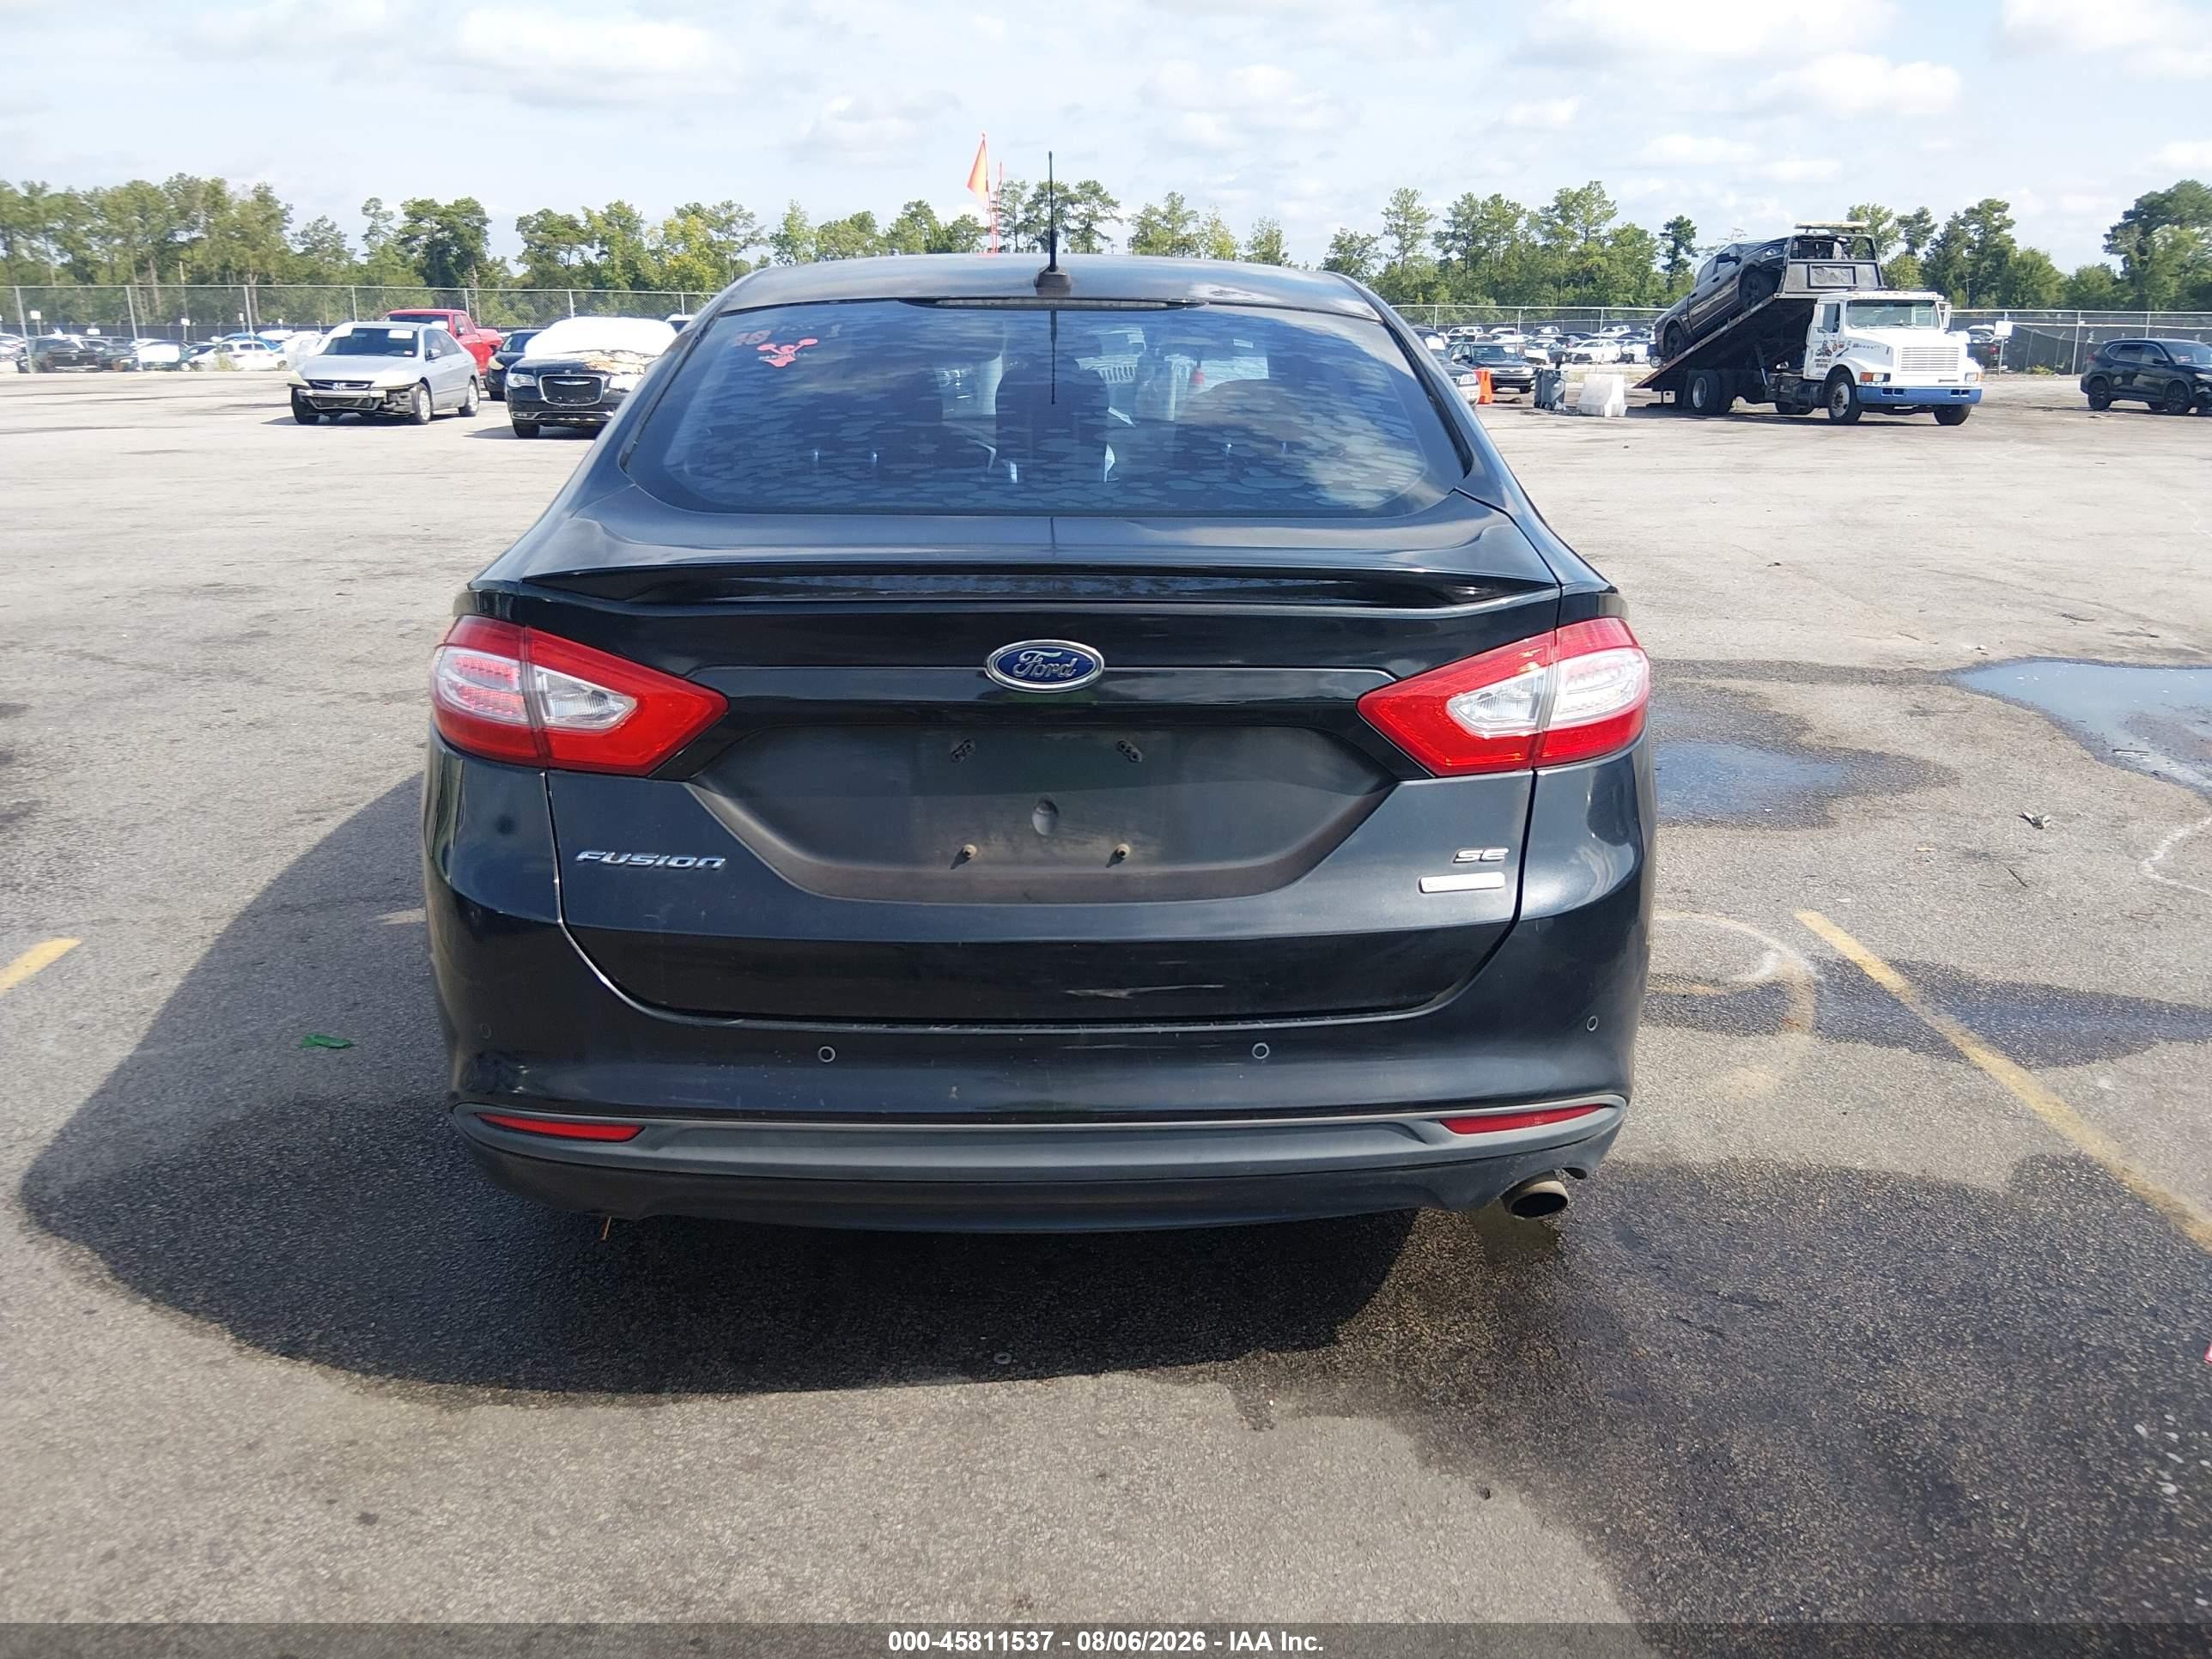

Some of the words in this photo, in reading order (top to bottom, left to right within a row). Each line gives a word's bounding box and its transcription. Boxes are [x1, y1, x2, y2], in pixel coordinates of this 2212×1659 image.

[1012, 650, 1077, 678] Ford
[576, 851, 726, 869] FUSION
[1453, 848, 1509, 864] SE
